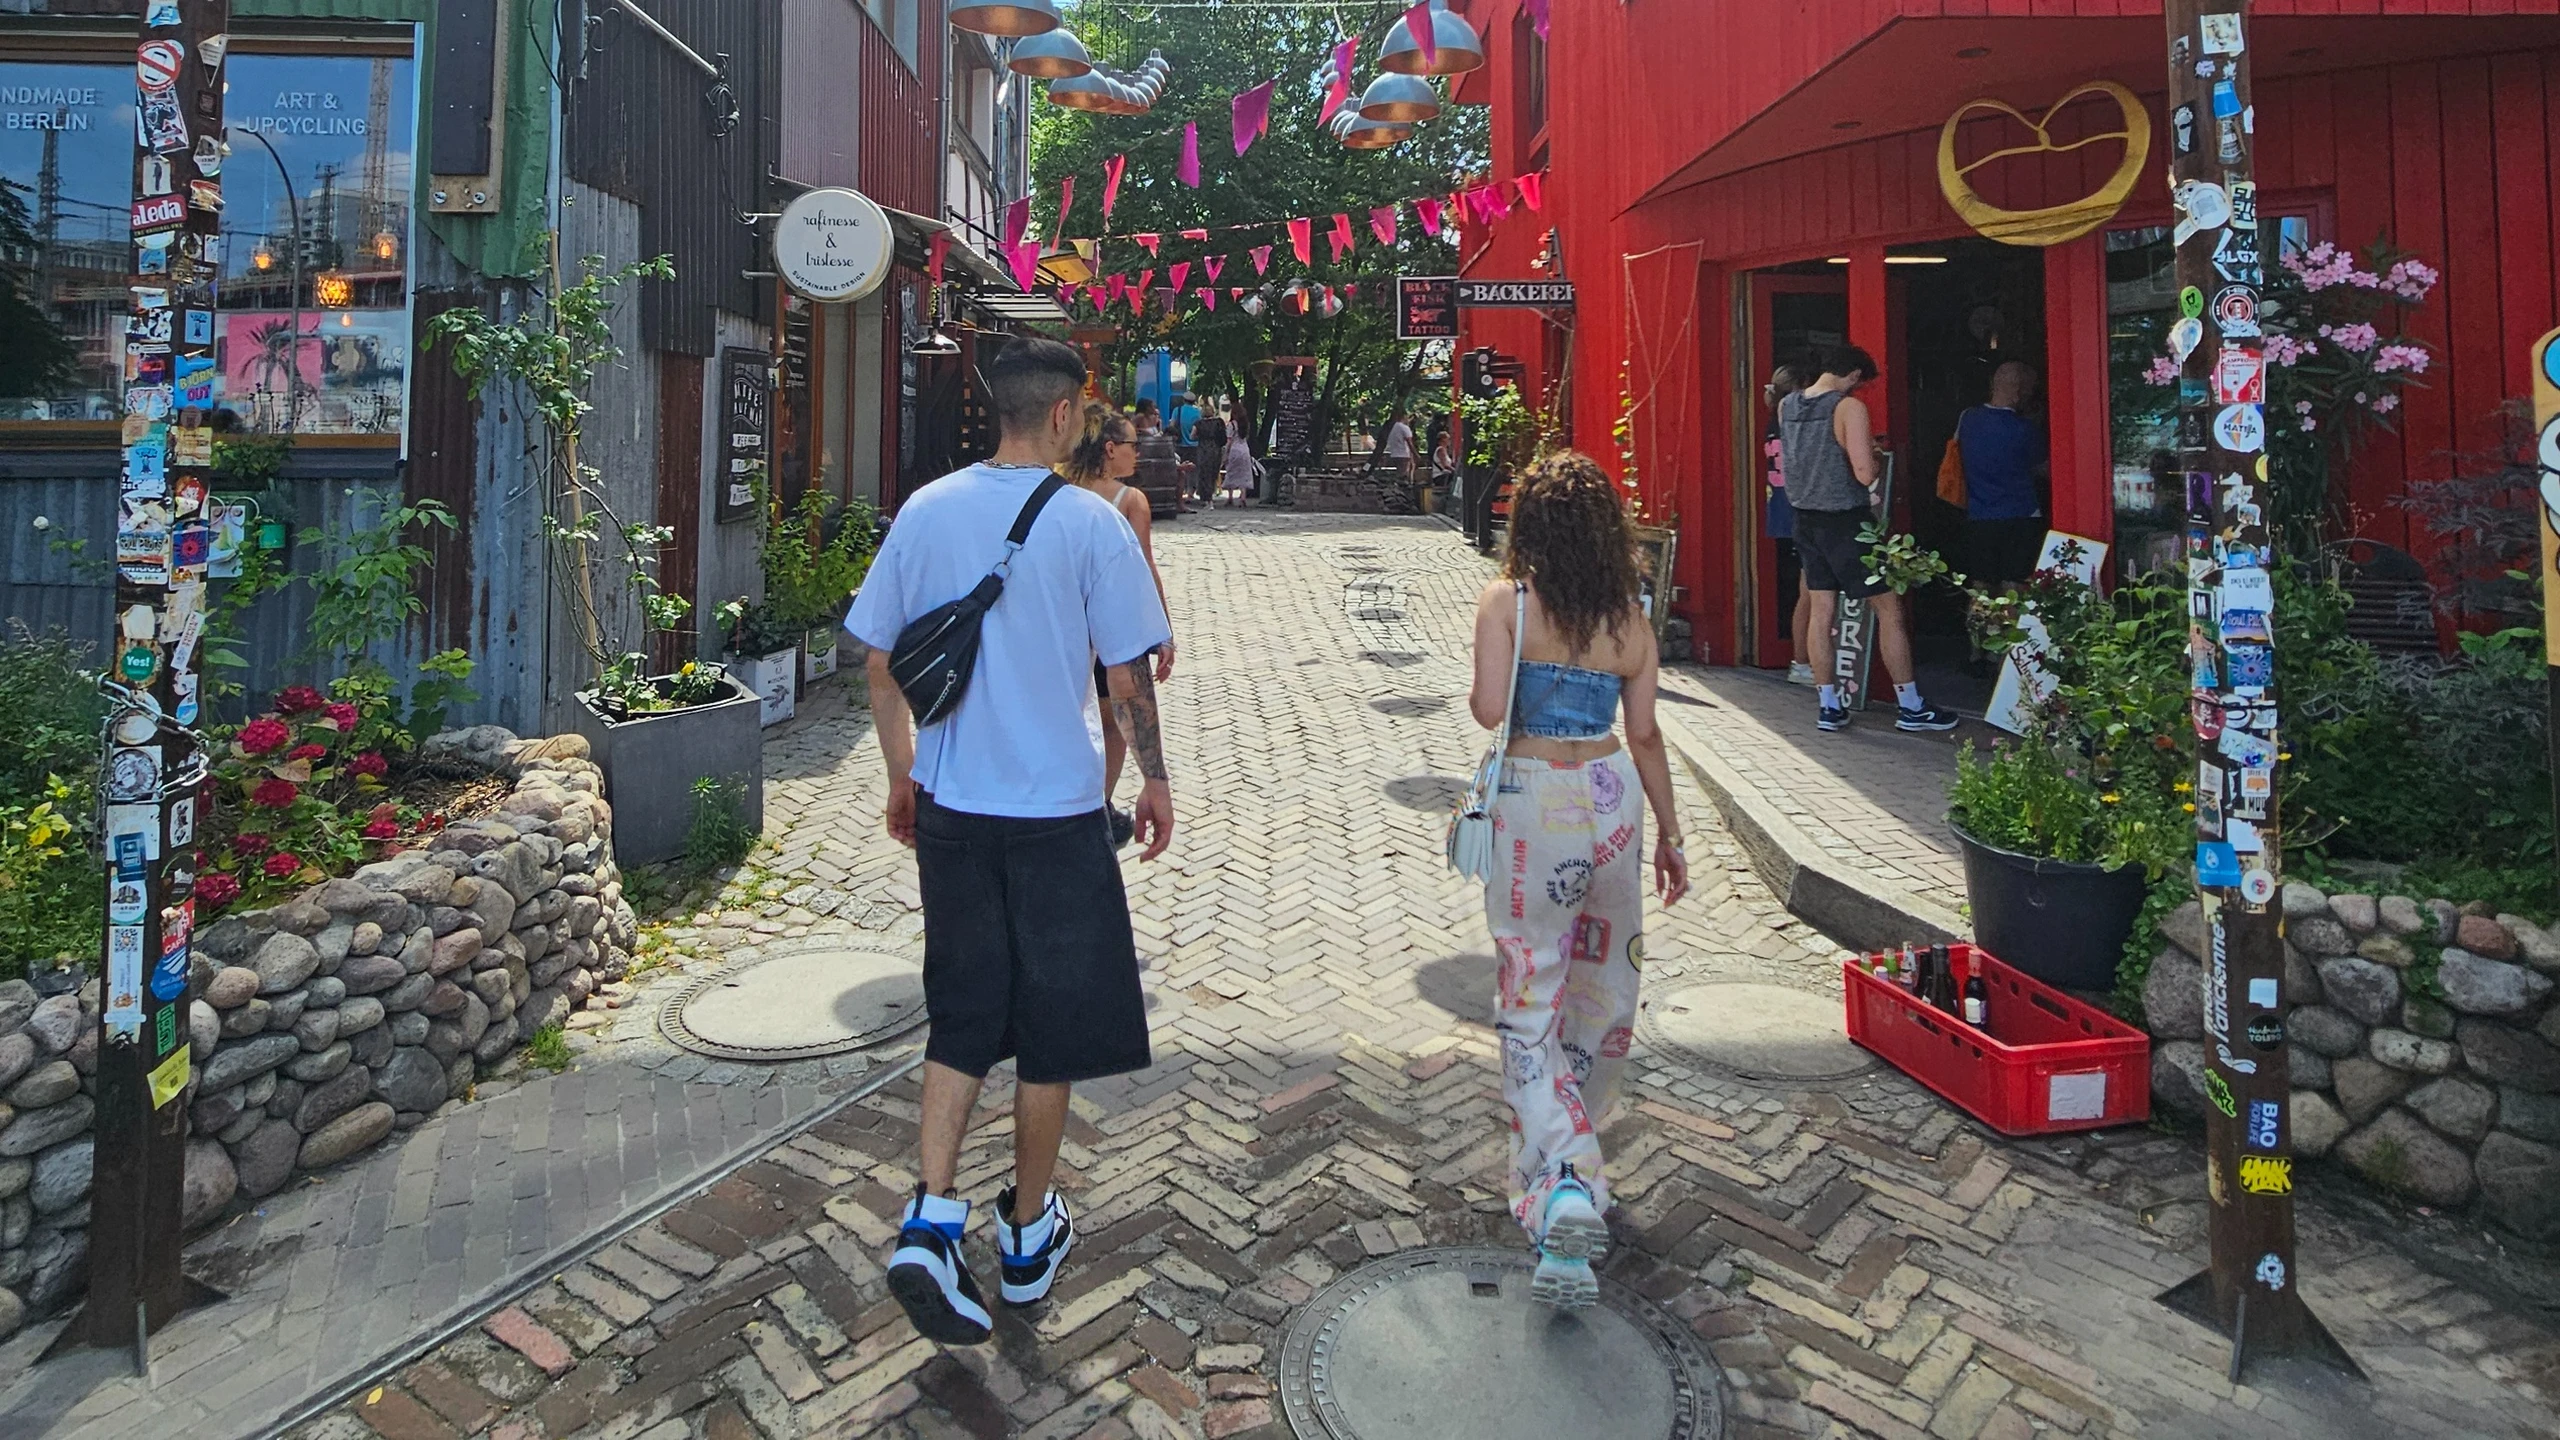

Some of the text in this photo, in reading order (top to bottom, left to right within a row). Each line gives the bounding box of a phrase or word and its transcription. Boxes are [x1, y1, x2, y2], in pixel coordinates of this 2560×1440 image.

[274, 92, 339, 111] ART &
[6, 112, 88, 130] BERLIN
[245, 116, 366, 135] UPCYCLING
[803, 209, 860, 235] rafinesse
[825, 232, 837, 249] &
[806, 252, 855, 268] tristesse
[792, 269, 866, 291] SUSTAINABLE DESIGN
[1408, 325, 1450, 335] TATTOO
[187, 385, 211, 401] OUT
[126, 656, 150, 667] Yes!
[1511, 839, 1527, 919] SALTY HAIR
[2260, 1102, 2278, 1148] BAO
